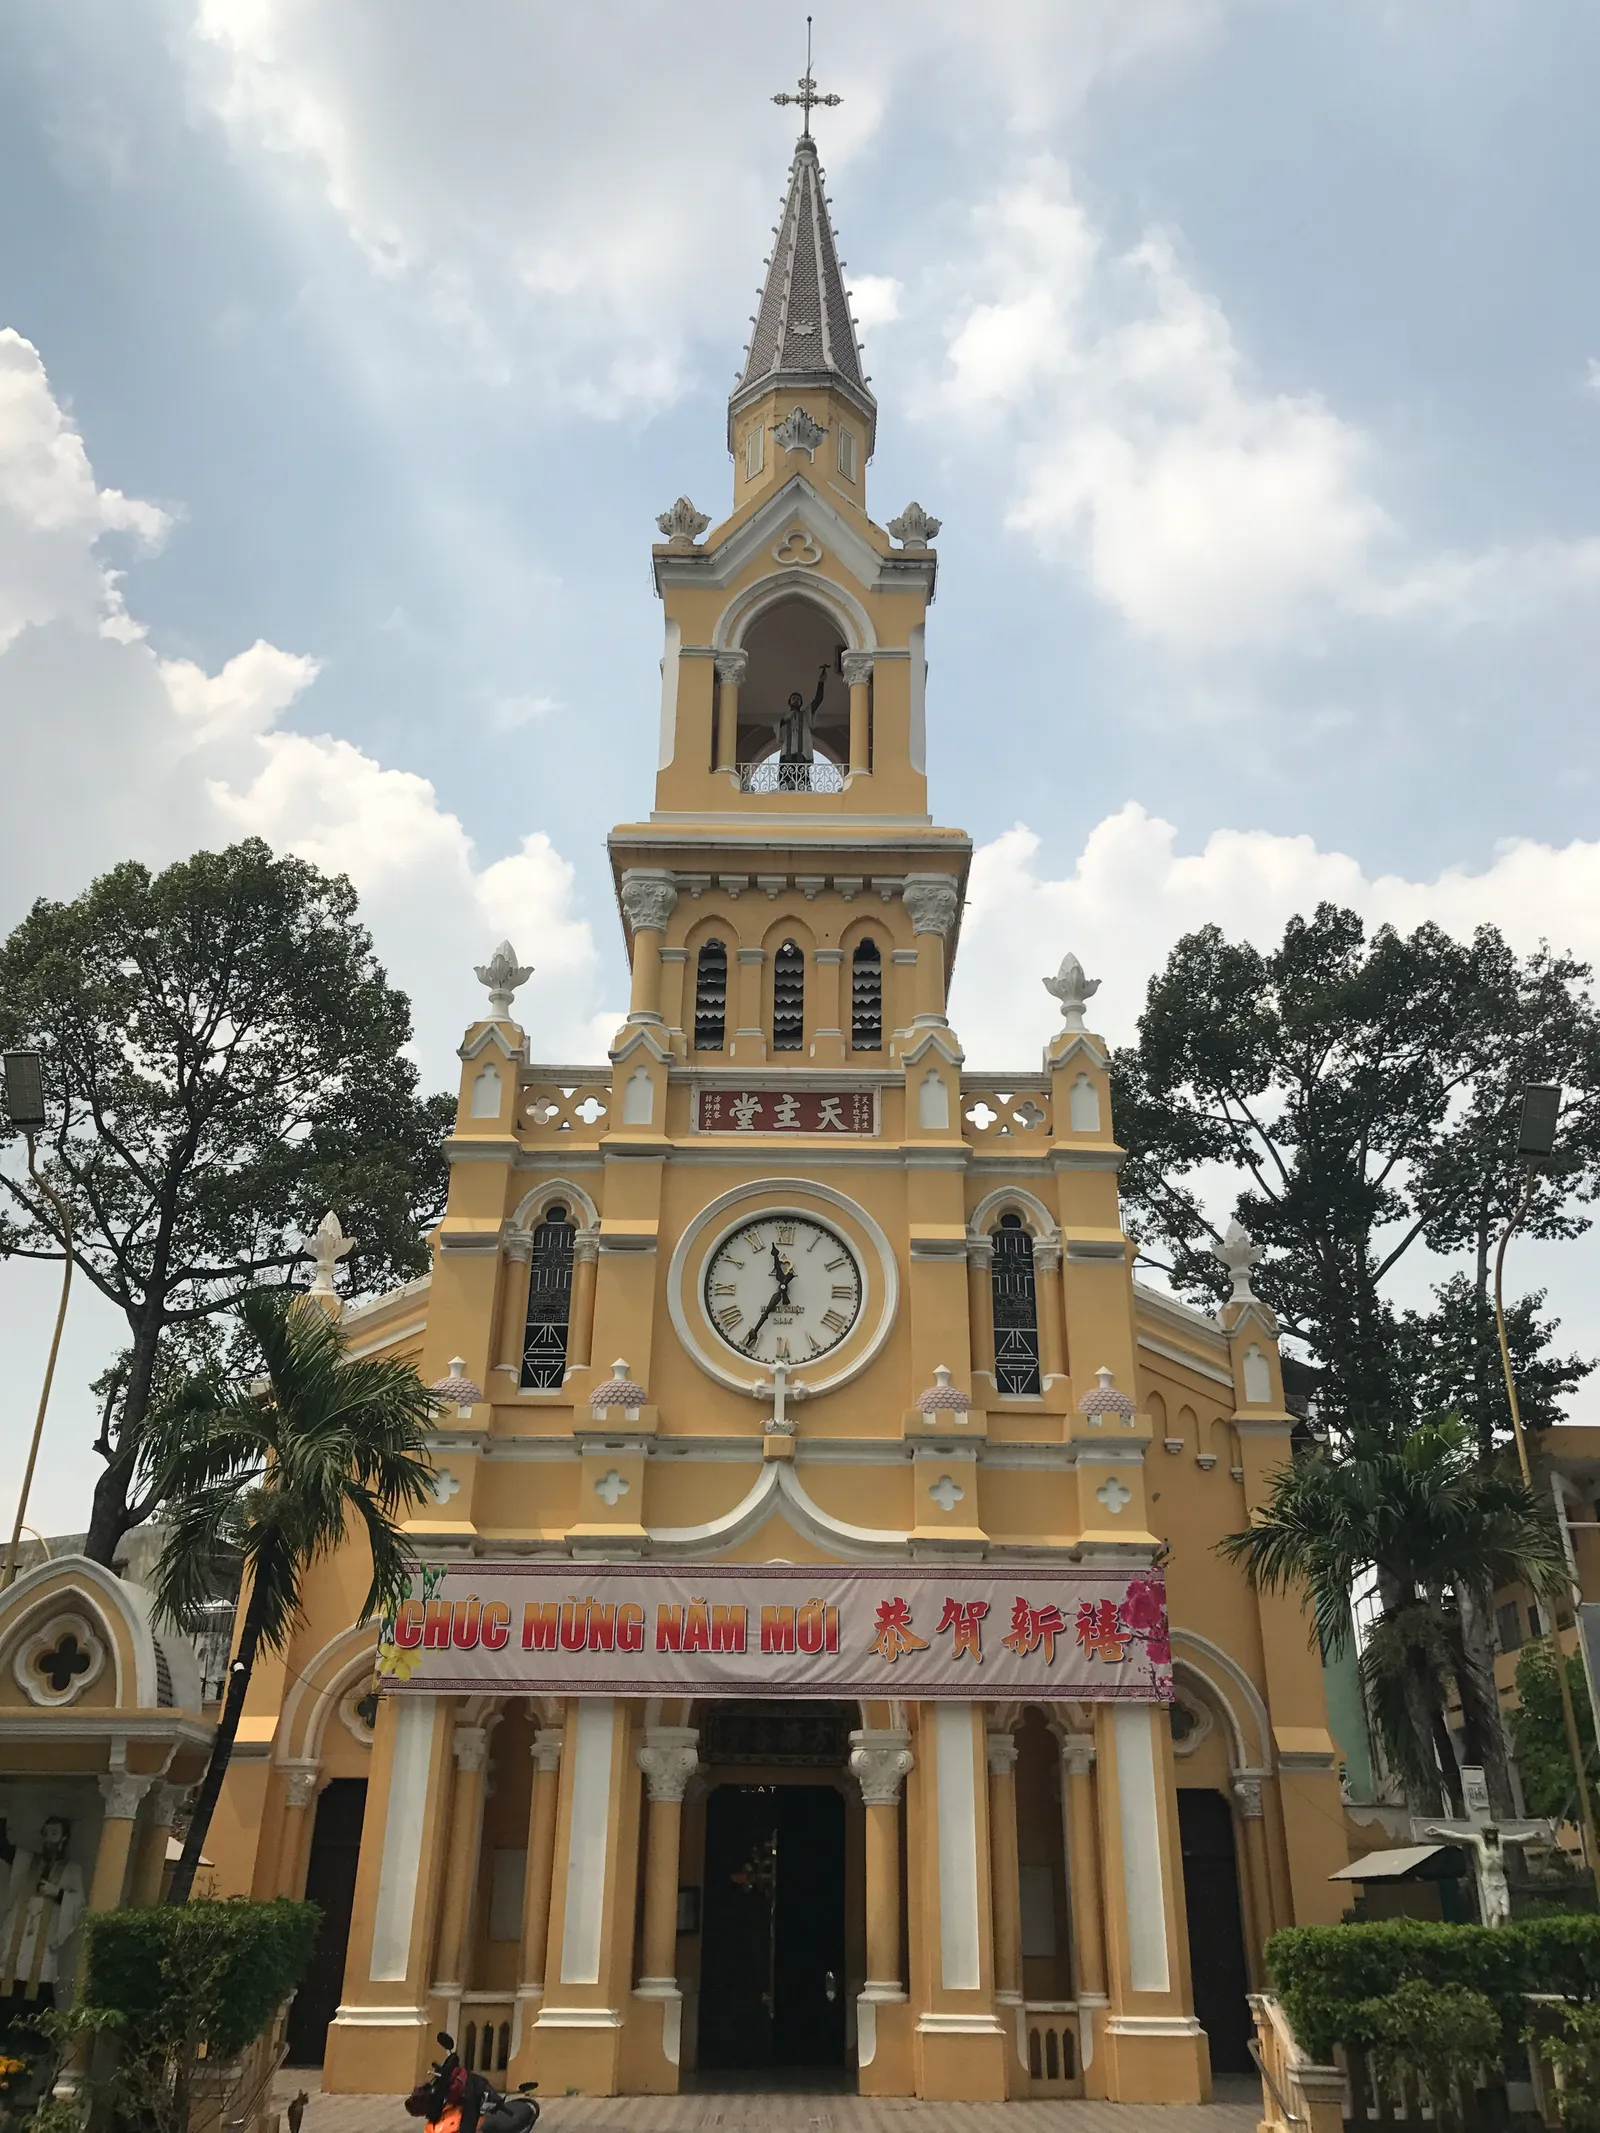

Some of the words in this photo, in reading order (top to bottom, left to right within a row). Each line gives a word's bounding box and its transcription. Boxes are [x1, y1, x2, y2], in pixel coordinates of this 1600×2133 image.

[394, 1594, 510, 1650] CHÚC
[521, 1595, 644, 1652] MỪNG
[656, 1597, 747, 1652] NĂM
[760, 1597, 839, 1653] MỚI
[867, 1595, 1132, 1665] 恭賀新禧
